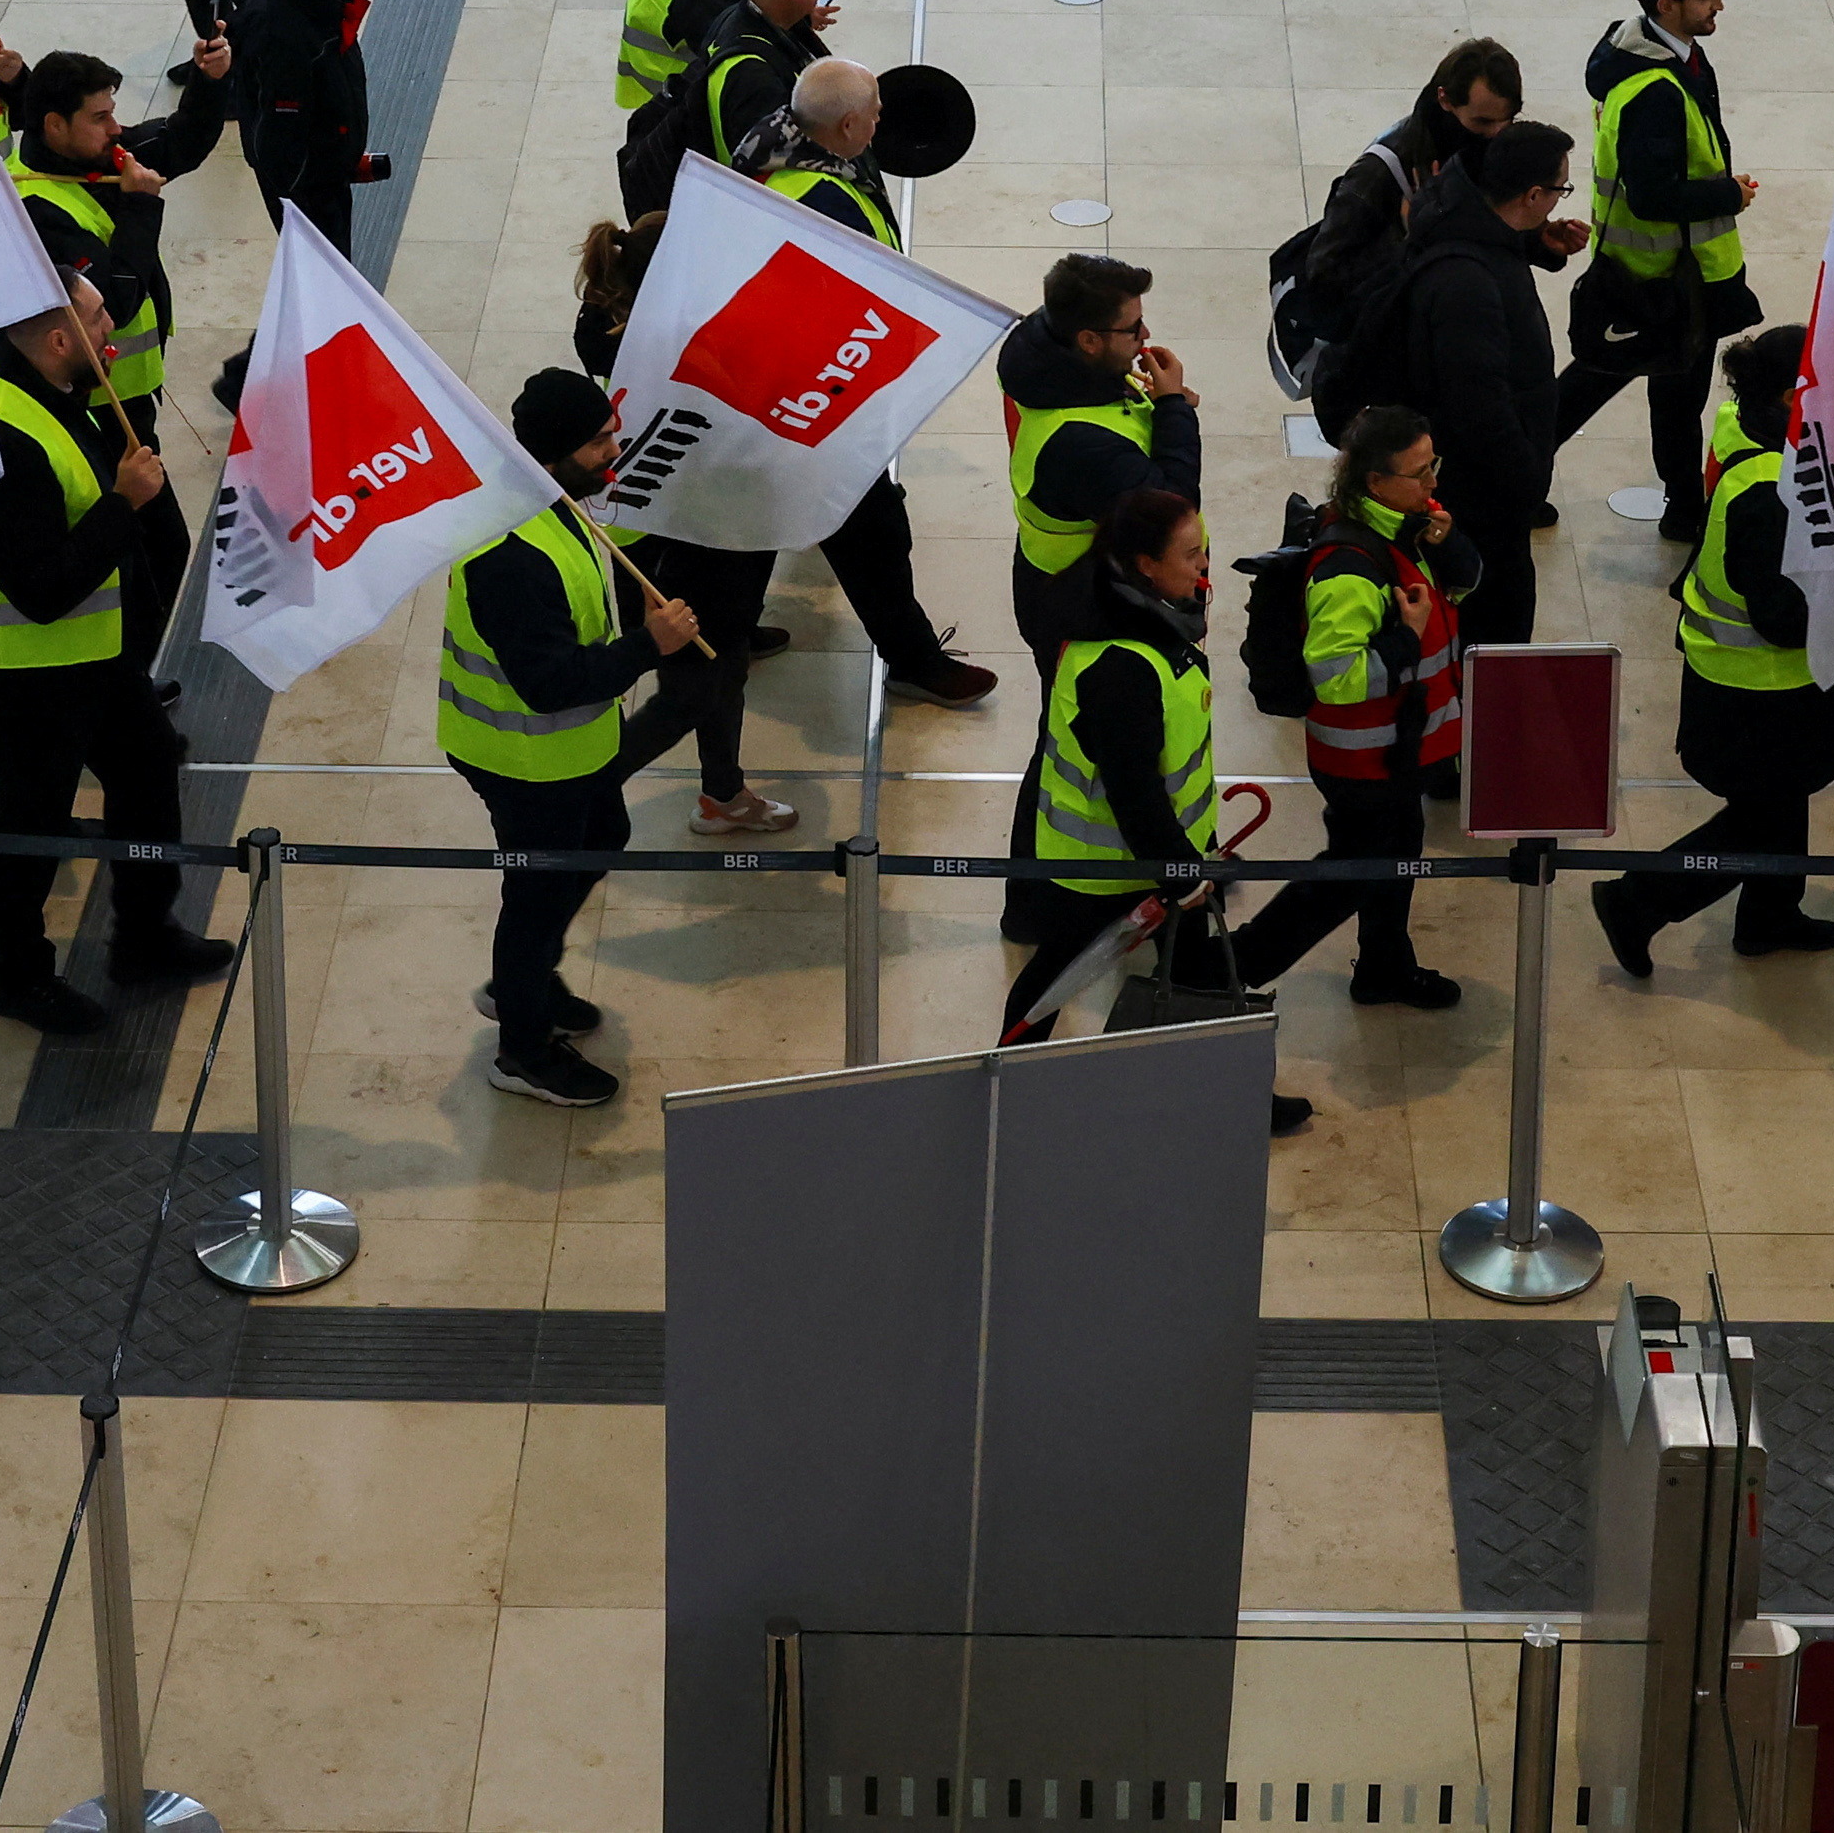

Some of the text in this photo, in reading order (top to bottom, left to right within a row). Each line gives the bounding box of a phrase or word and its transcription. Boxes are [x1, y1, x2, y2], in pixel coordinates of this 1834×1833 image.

[129, 845, 163, 860] BER
[280, 847, 298, 863] ER
[493, 852, 527, 867] BER
[723, 854, 759, 869] BER
[933, 859, 969, 874] BER
[1397, 861, 1432, 876] BER
[1683, 855, 1719, 870] BER
[1165, 863, 1201, 877] BER
